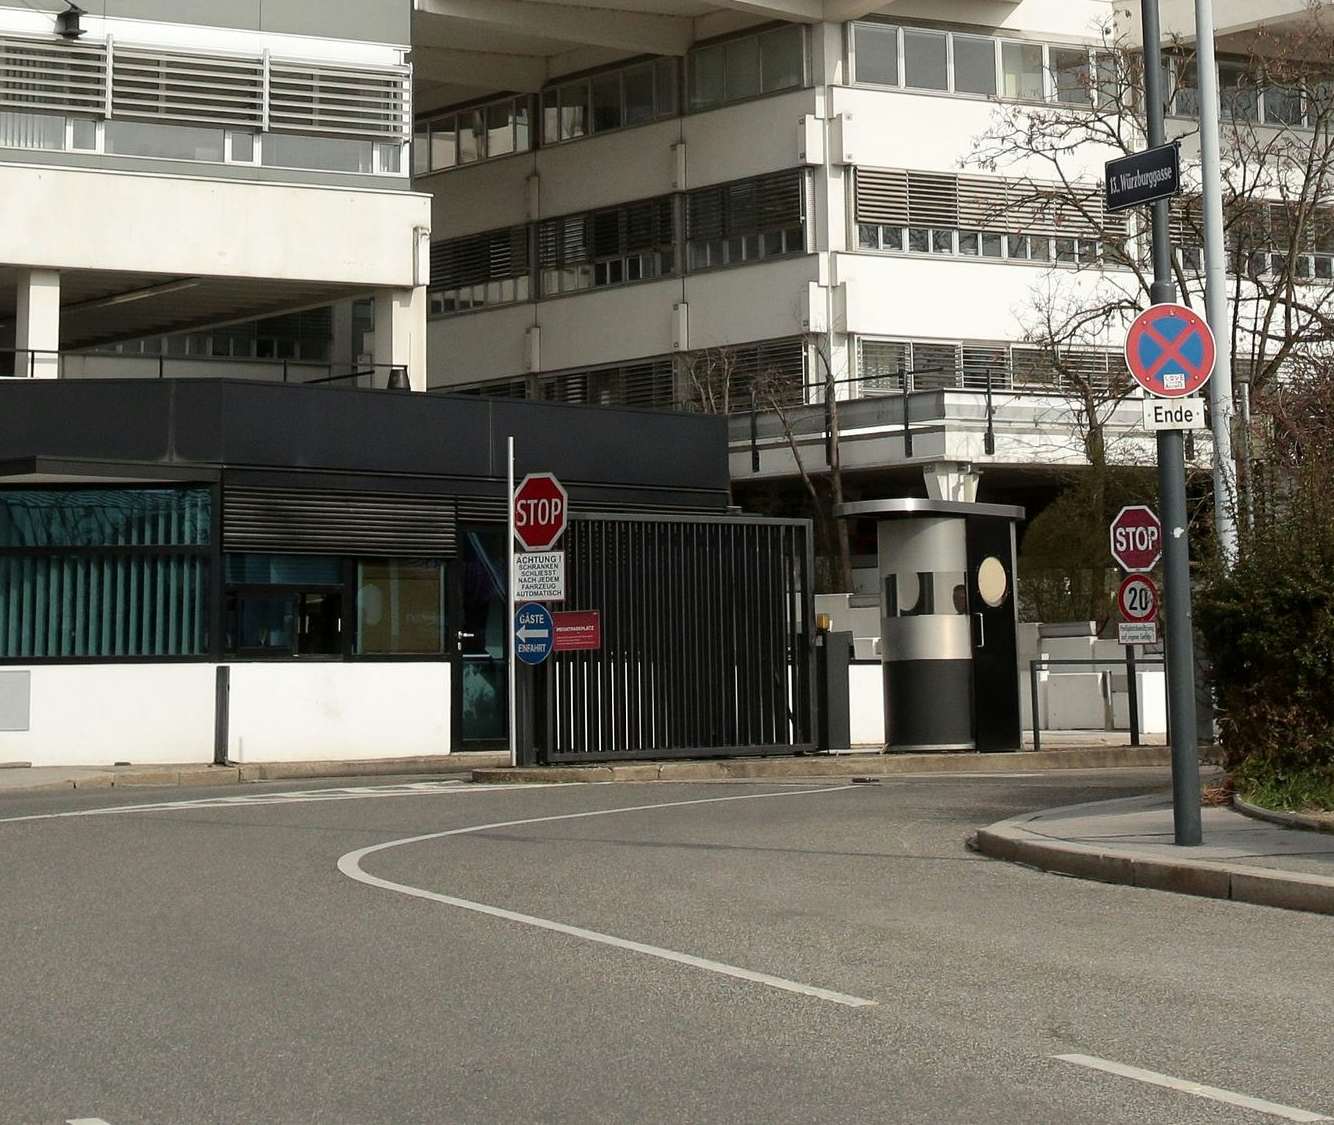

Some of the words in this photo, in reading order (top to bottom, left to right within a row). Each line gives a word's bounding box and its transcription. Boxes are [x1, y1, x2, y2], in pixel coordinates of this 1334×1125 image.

[1120, 167, 1172, 191] Würzburggasse
[1154, 406, 1193, 423] Ende
[516, 498, 562, 526] STOP
[1116, 526, 1158, 552] STOP
[516, 555, 557, 564] ACHTUNG
[1128, 586, 1149, 611] 20
[519, 612, 544, 624] GÄSTE
[518, 643, 546, 653] EINFAHRT
